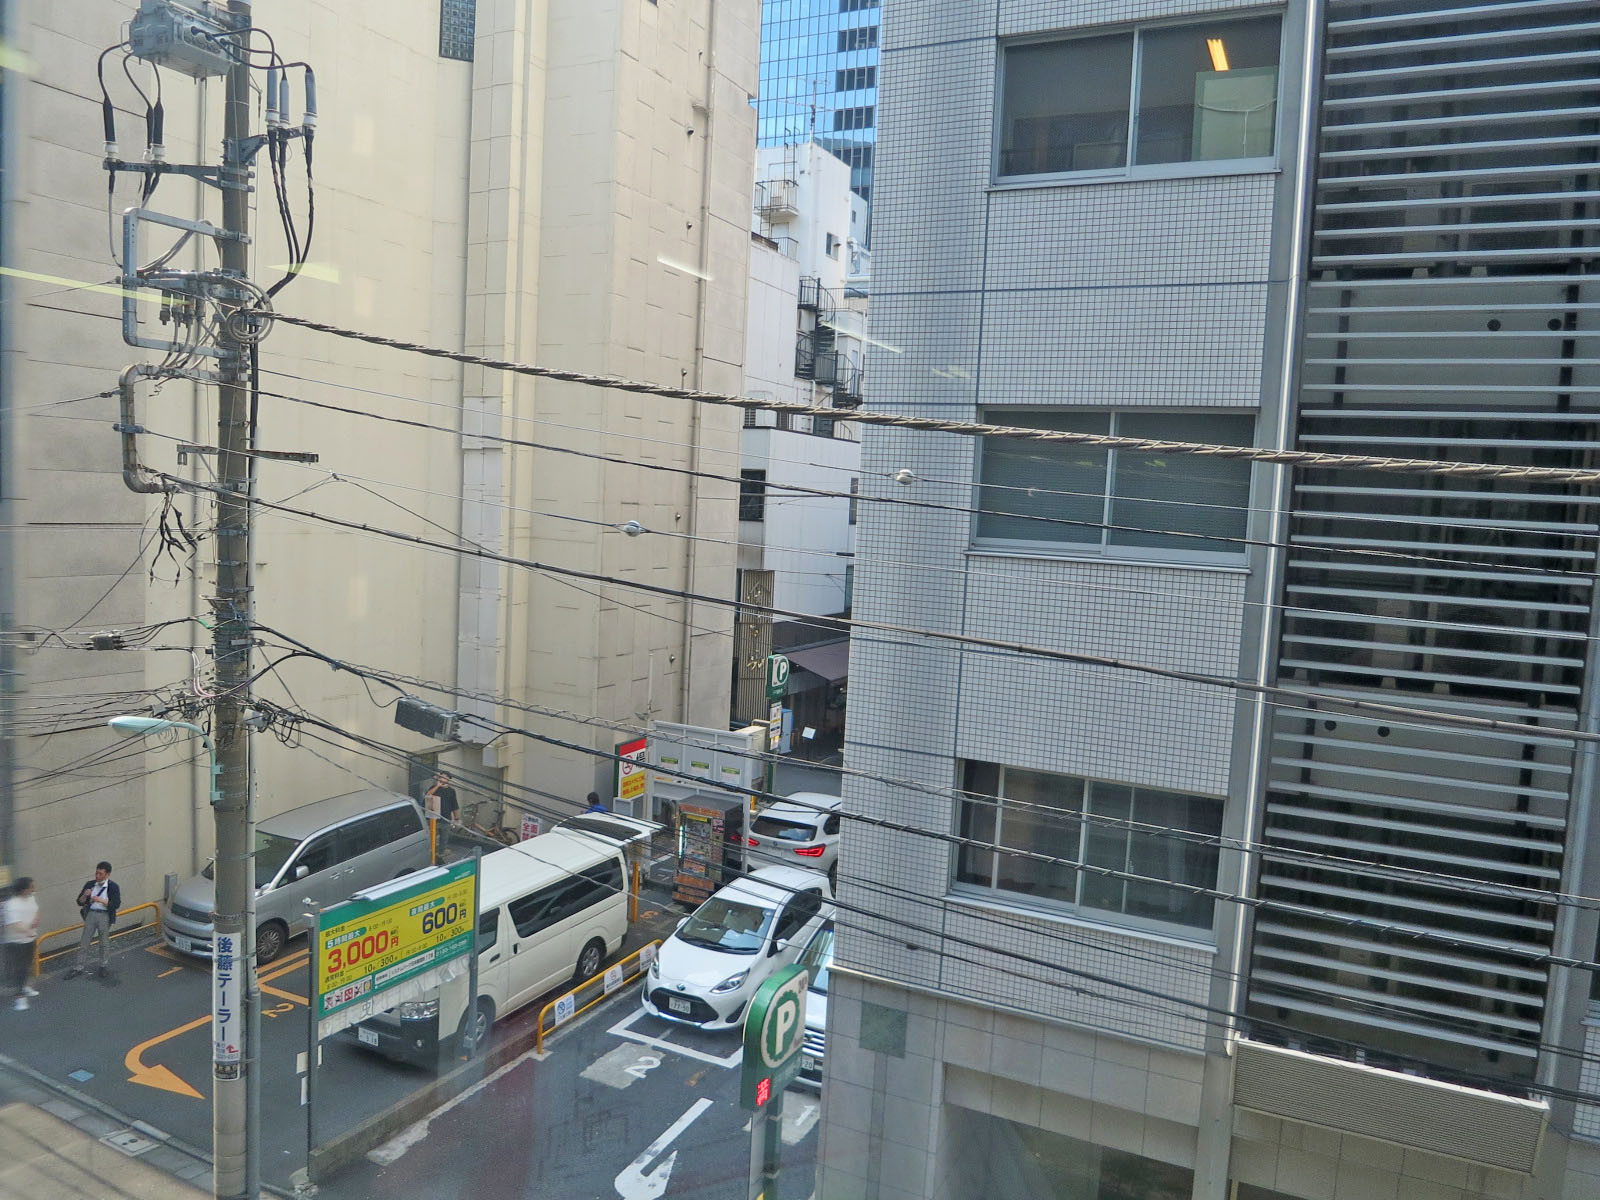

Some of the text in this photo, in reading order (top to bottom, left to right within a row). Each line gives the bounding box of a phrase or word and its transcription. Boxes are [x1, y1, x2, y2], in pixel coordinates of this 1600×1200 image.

[780, 661, 787, 681] P
[217, 936, 234, 1042] 後藤テーラー
[775, 1000, 796, 1056] P
[623, 1056, 662, 1079] 2
